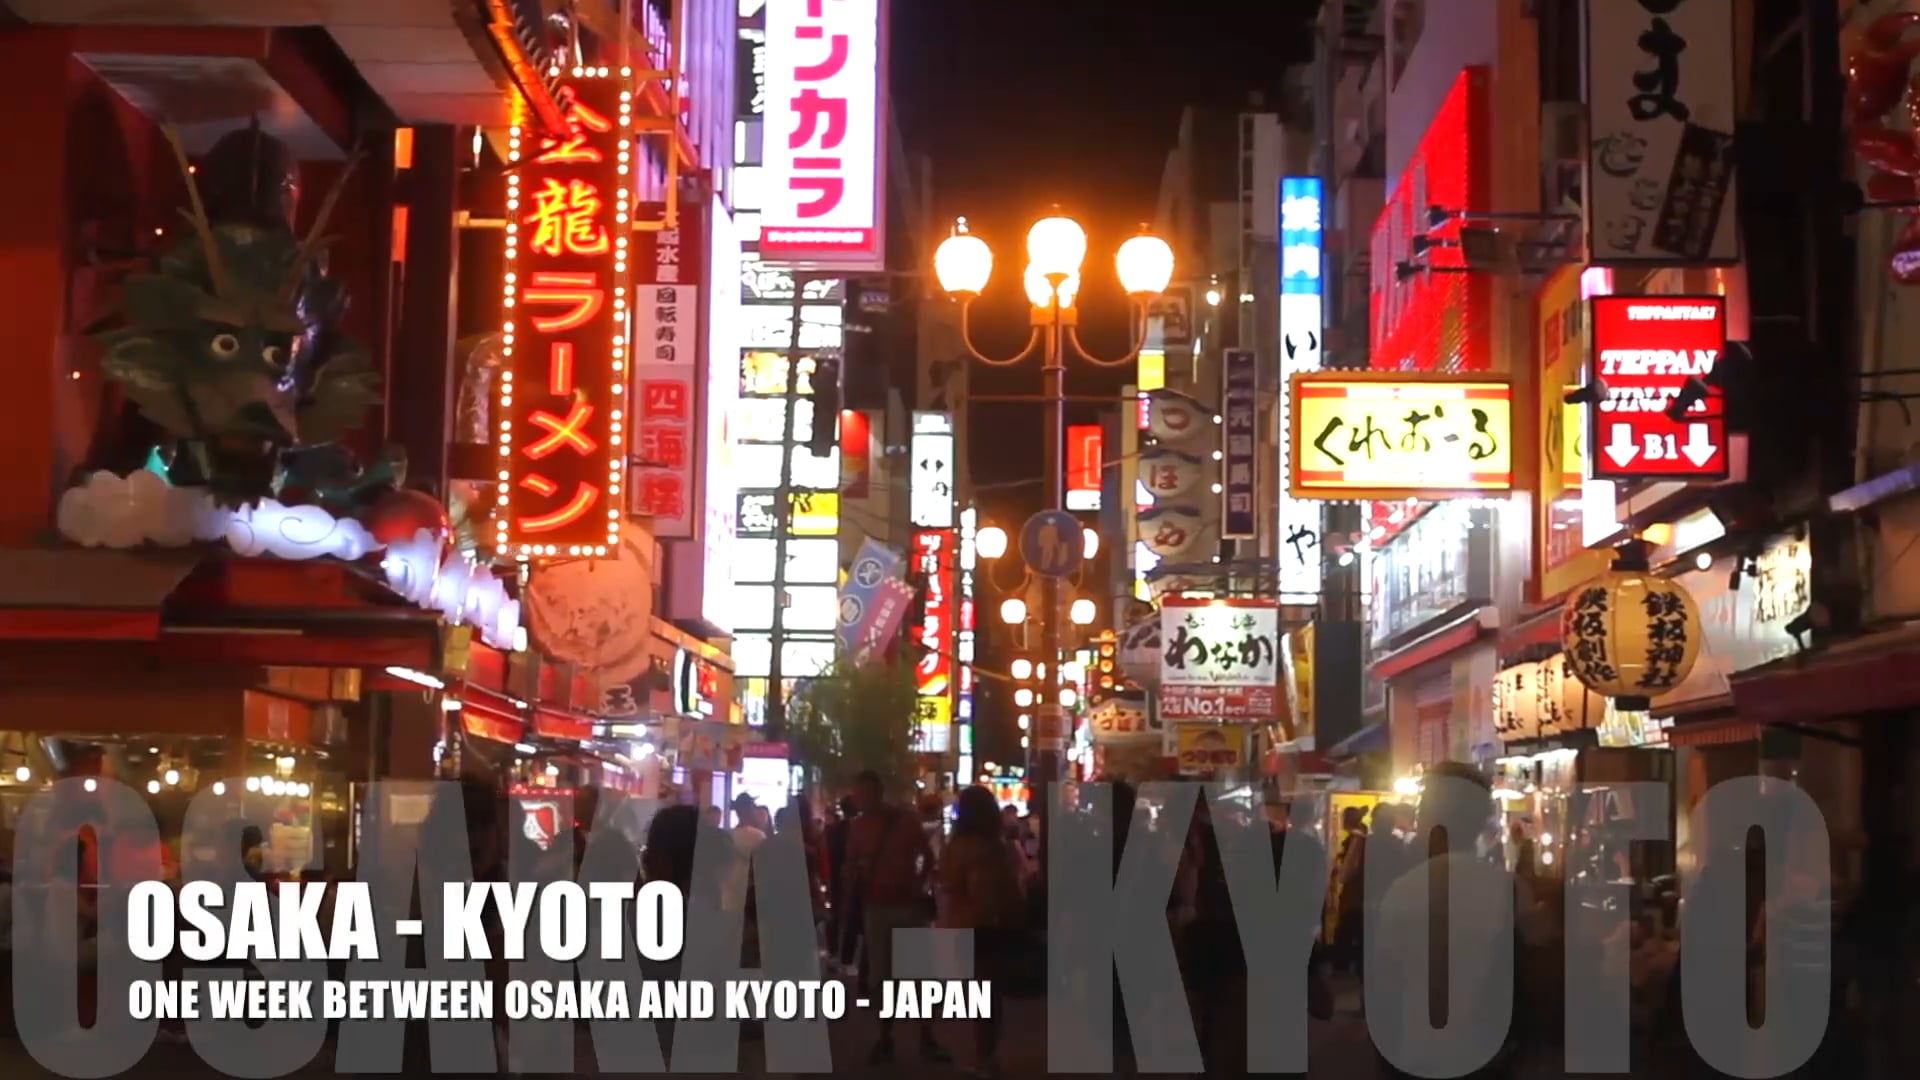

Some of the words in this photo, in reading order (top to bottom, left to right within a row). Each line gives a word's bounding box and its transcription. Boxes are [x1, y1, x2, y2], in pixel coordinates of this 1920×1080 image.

[788, 0, 849, 219] ンカラ
[518, 84, 614, 534] 金龍ラーメン
[1600, 349, 1718, 375] TEPPAN
[1313, 404, 1497, 466] くれおーる
[1643, 433, 1679, 460] B1
[1164, 626, 1273, 670] わなか
[1636, 591, 1688, 688] 鉄板神社
